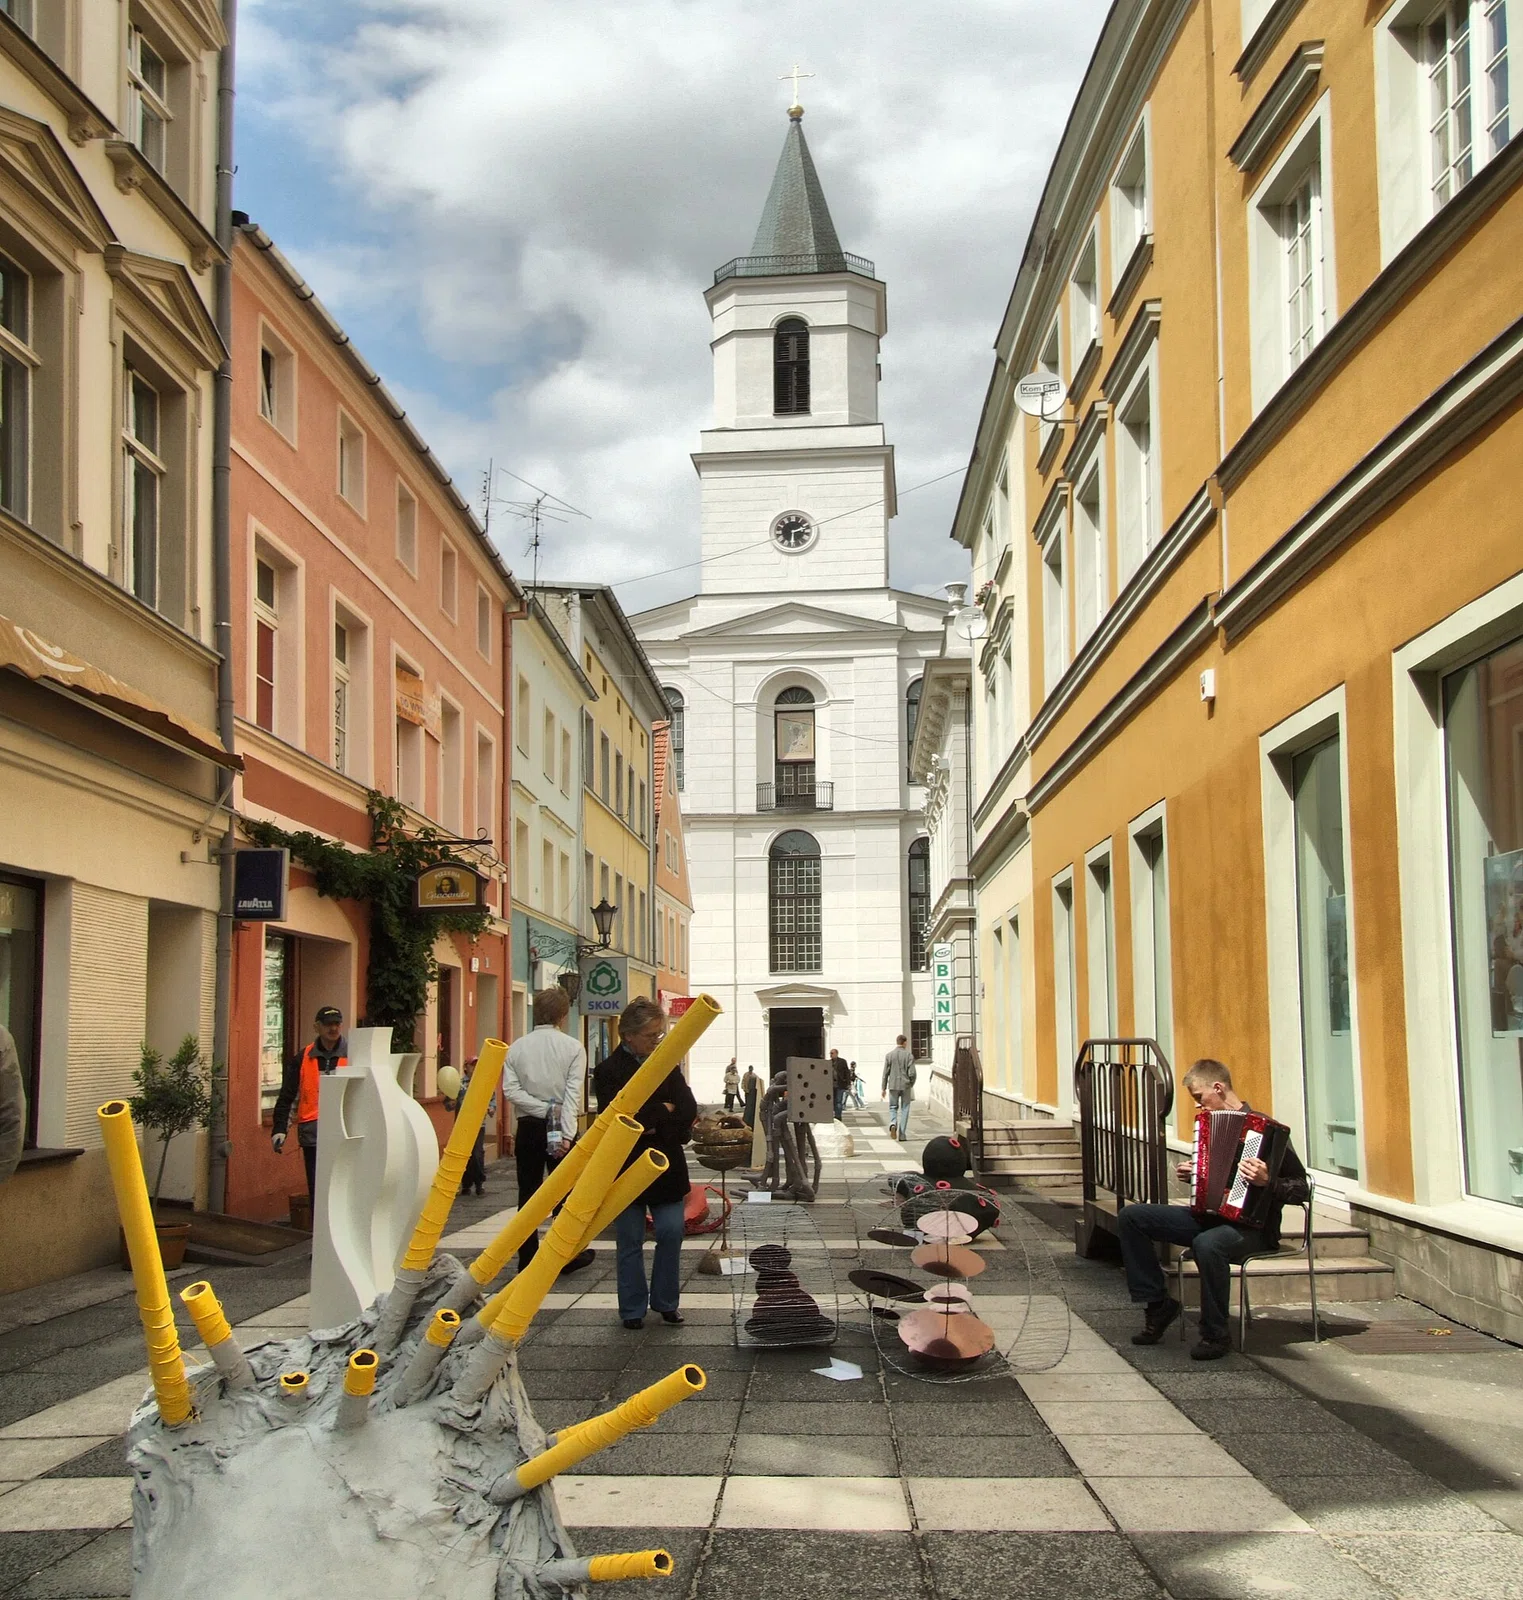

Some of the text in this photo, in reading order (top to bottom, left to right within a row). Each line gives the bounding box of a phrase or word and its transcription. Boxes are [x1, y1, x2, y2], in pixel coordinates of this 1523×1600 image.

[237, 897, 274, 908] LAVAZZA
[936, 964, 951, 1032] BANK
[588, 1000, 620, 1010] SKOK
